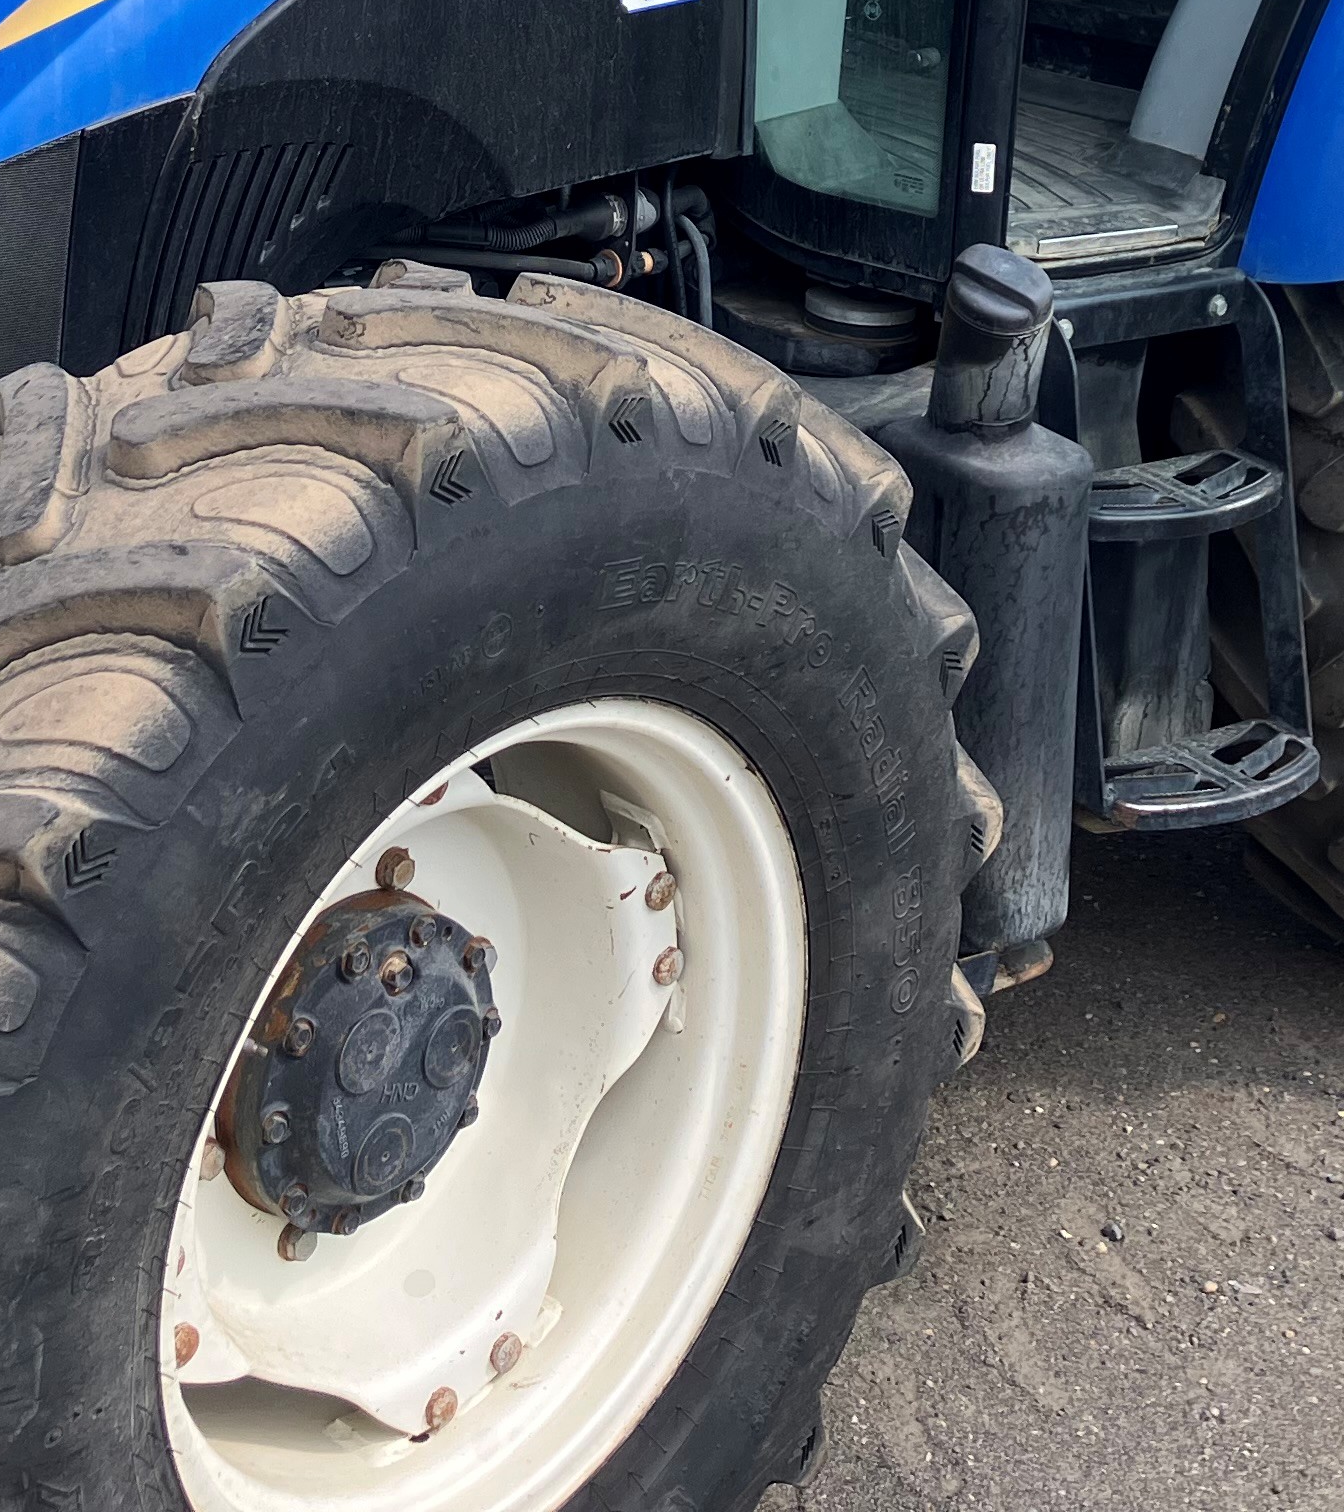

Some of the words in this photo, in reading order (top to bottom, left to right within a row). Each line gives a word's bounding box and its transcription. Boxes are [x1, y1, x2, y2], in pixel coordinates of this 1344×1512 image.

[597, 555, 835, 671] Earth-Pro
[838, 665, 918, 857] Radial
[890, 862, 922, 1015] 850
[379, 1081, 419, 1105] CNH
